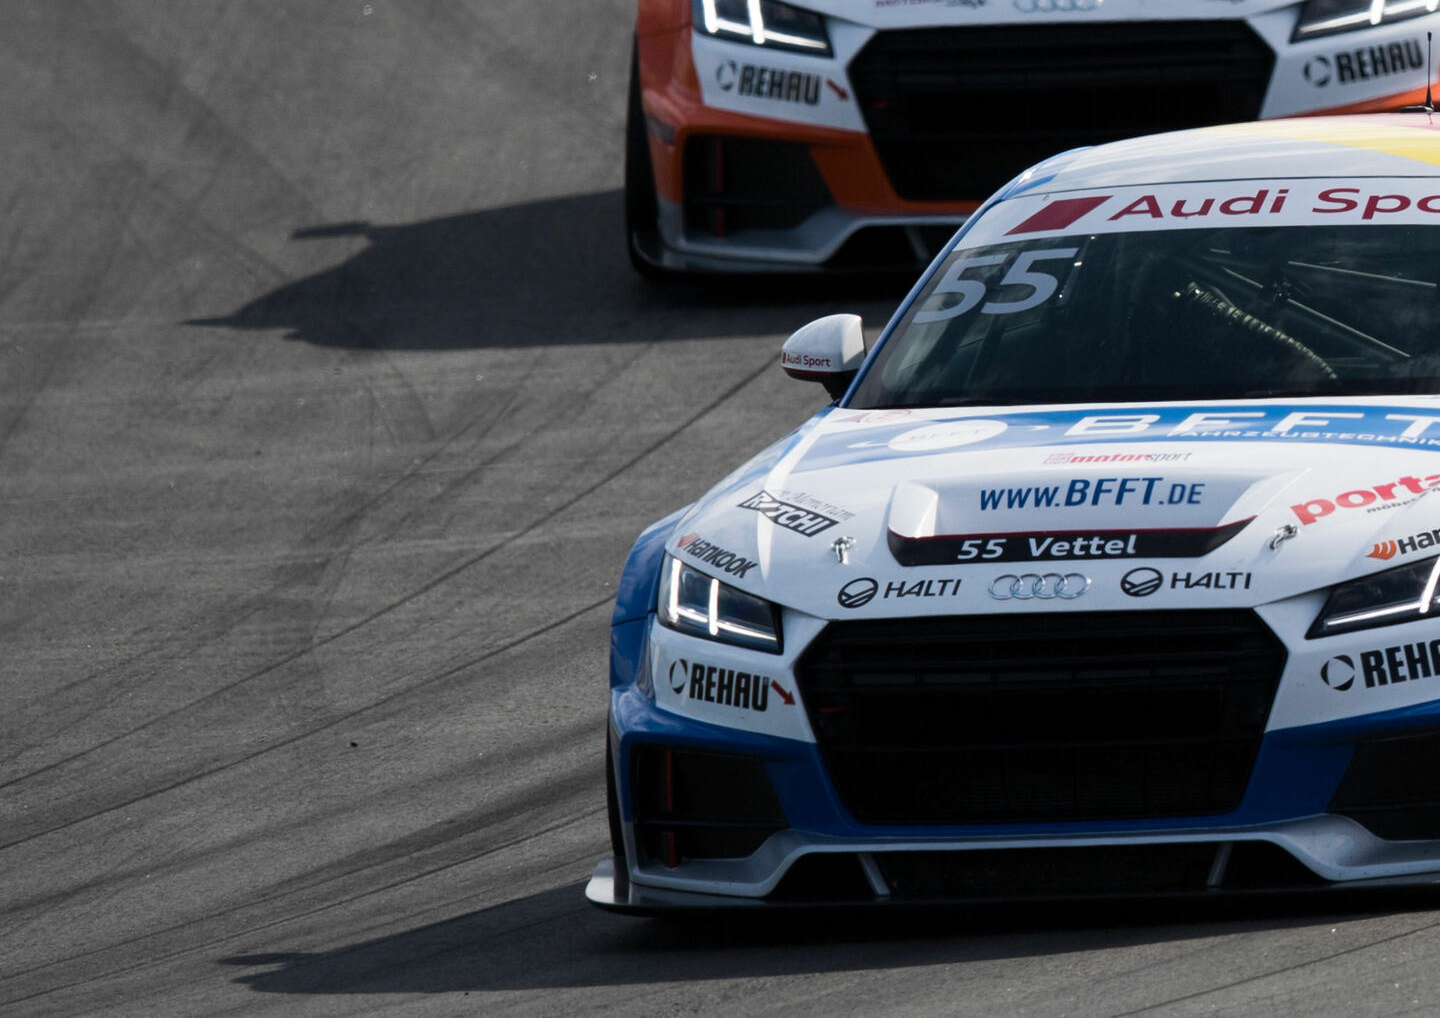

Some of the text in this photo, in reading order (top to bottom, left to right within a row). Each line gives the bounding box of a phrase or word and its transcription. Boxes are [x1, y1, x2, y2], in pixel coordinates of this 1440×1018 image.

[1336, 38, 1424, 83] REHAU
[737, 63, 822, 106] REHAU
[1108, 189, 1289, 221] Audi
[911, 247, 1080, 325] 55
[786, 353, 831, 368] Audi Sport
[956, 534, 1137, 560] 55 Vettel
[883, 577, 962, 600] HALTI
[1169, 570, 1252, 591] HALTI
[688, 662, 771, 712] REHAU
